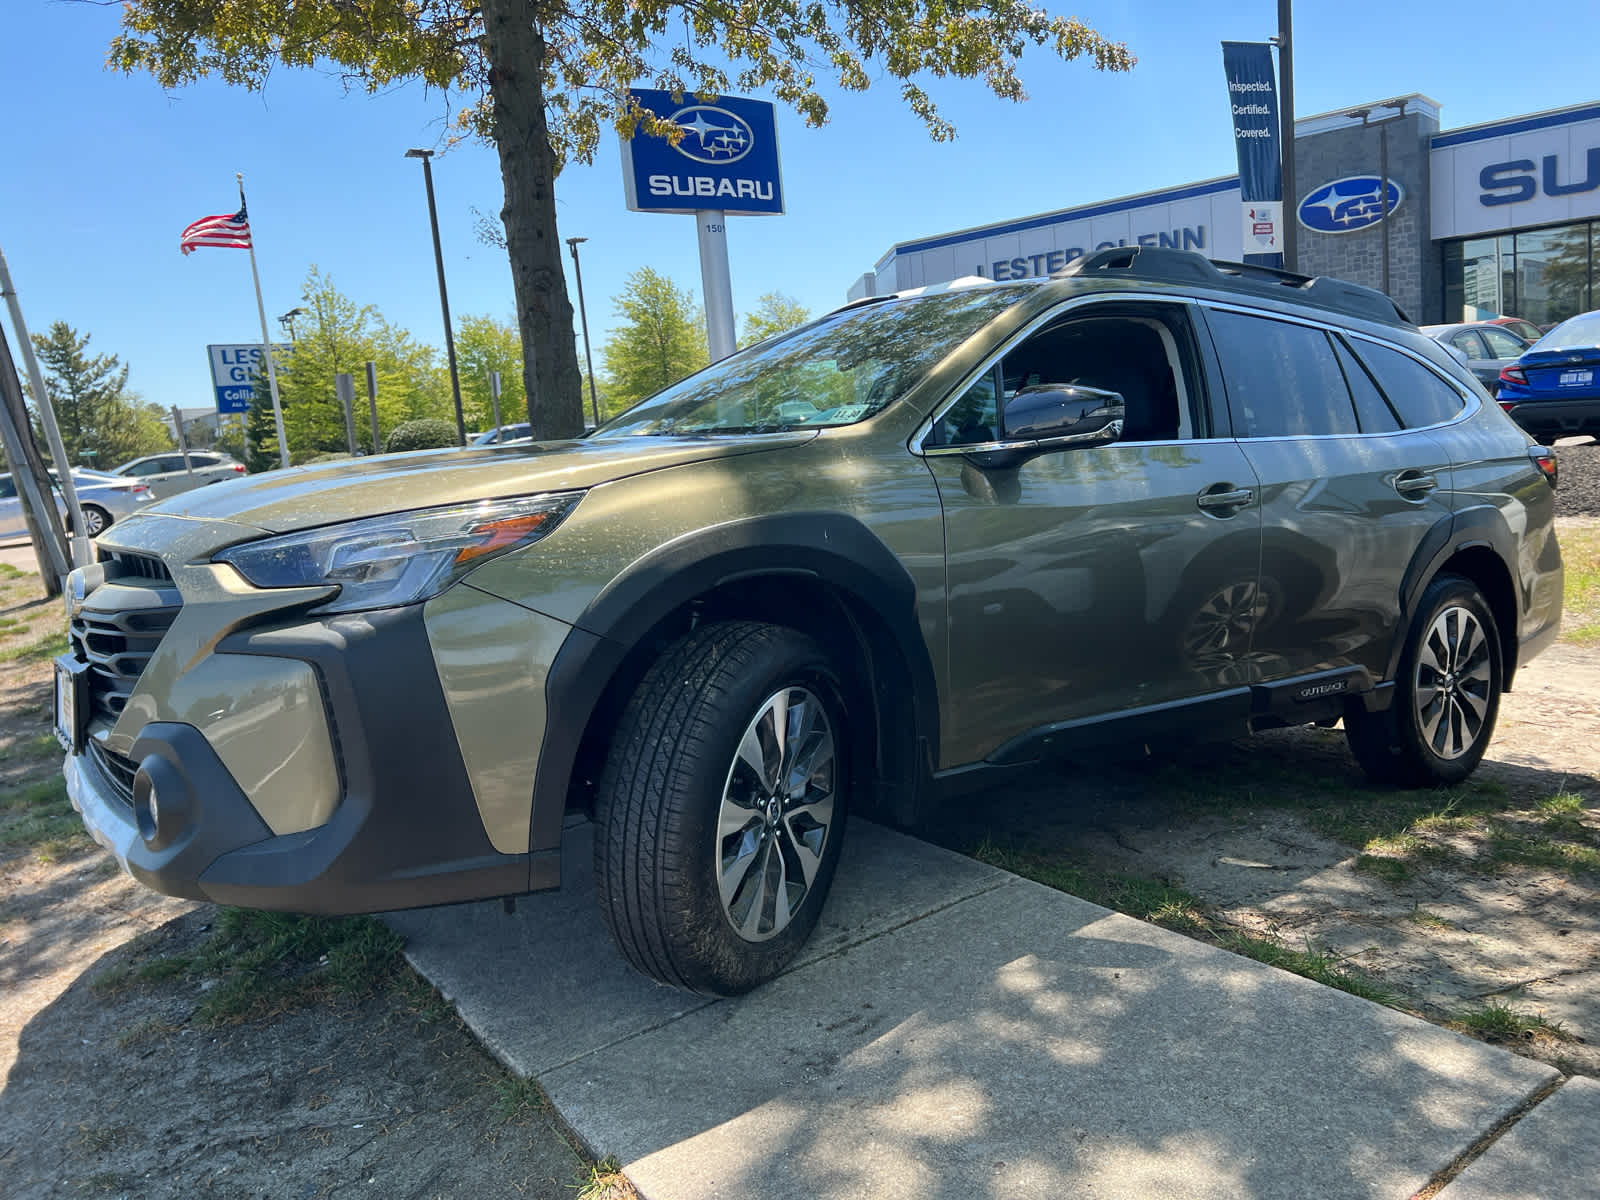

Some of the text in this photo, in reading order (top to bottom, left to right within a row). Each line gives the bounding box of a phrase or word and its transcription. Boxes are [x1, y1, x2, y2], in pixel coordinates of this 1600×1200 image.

[1229, 80, 1272, 94] Inspected.
[1232, 104, 1271, 115] Certified.
[1235, 127, 1271, 138] Covered.
[649, 175, 773, 200] SUBARU
[224, 389, 260, 401] Collis
